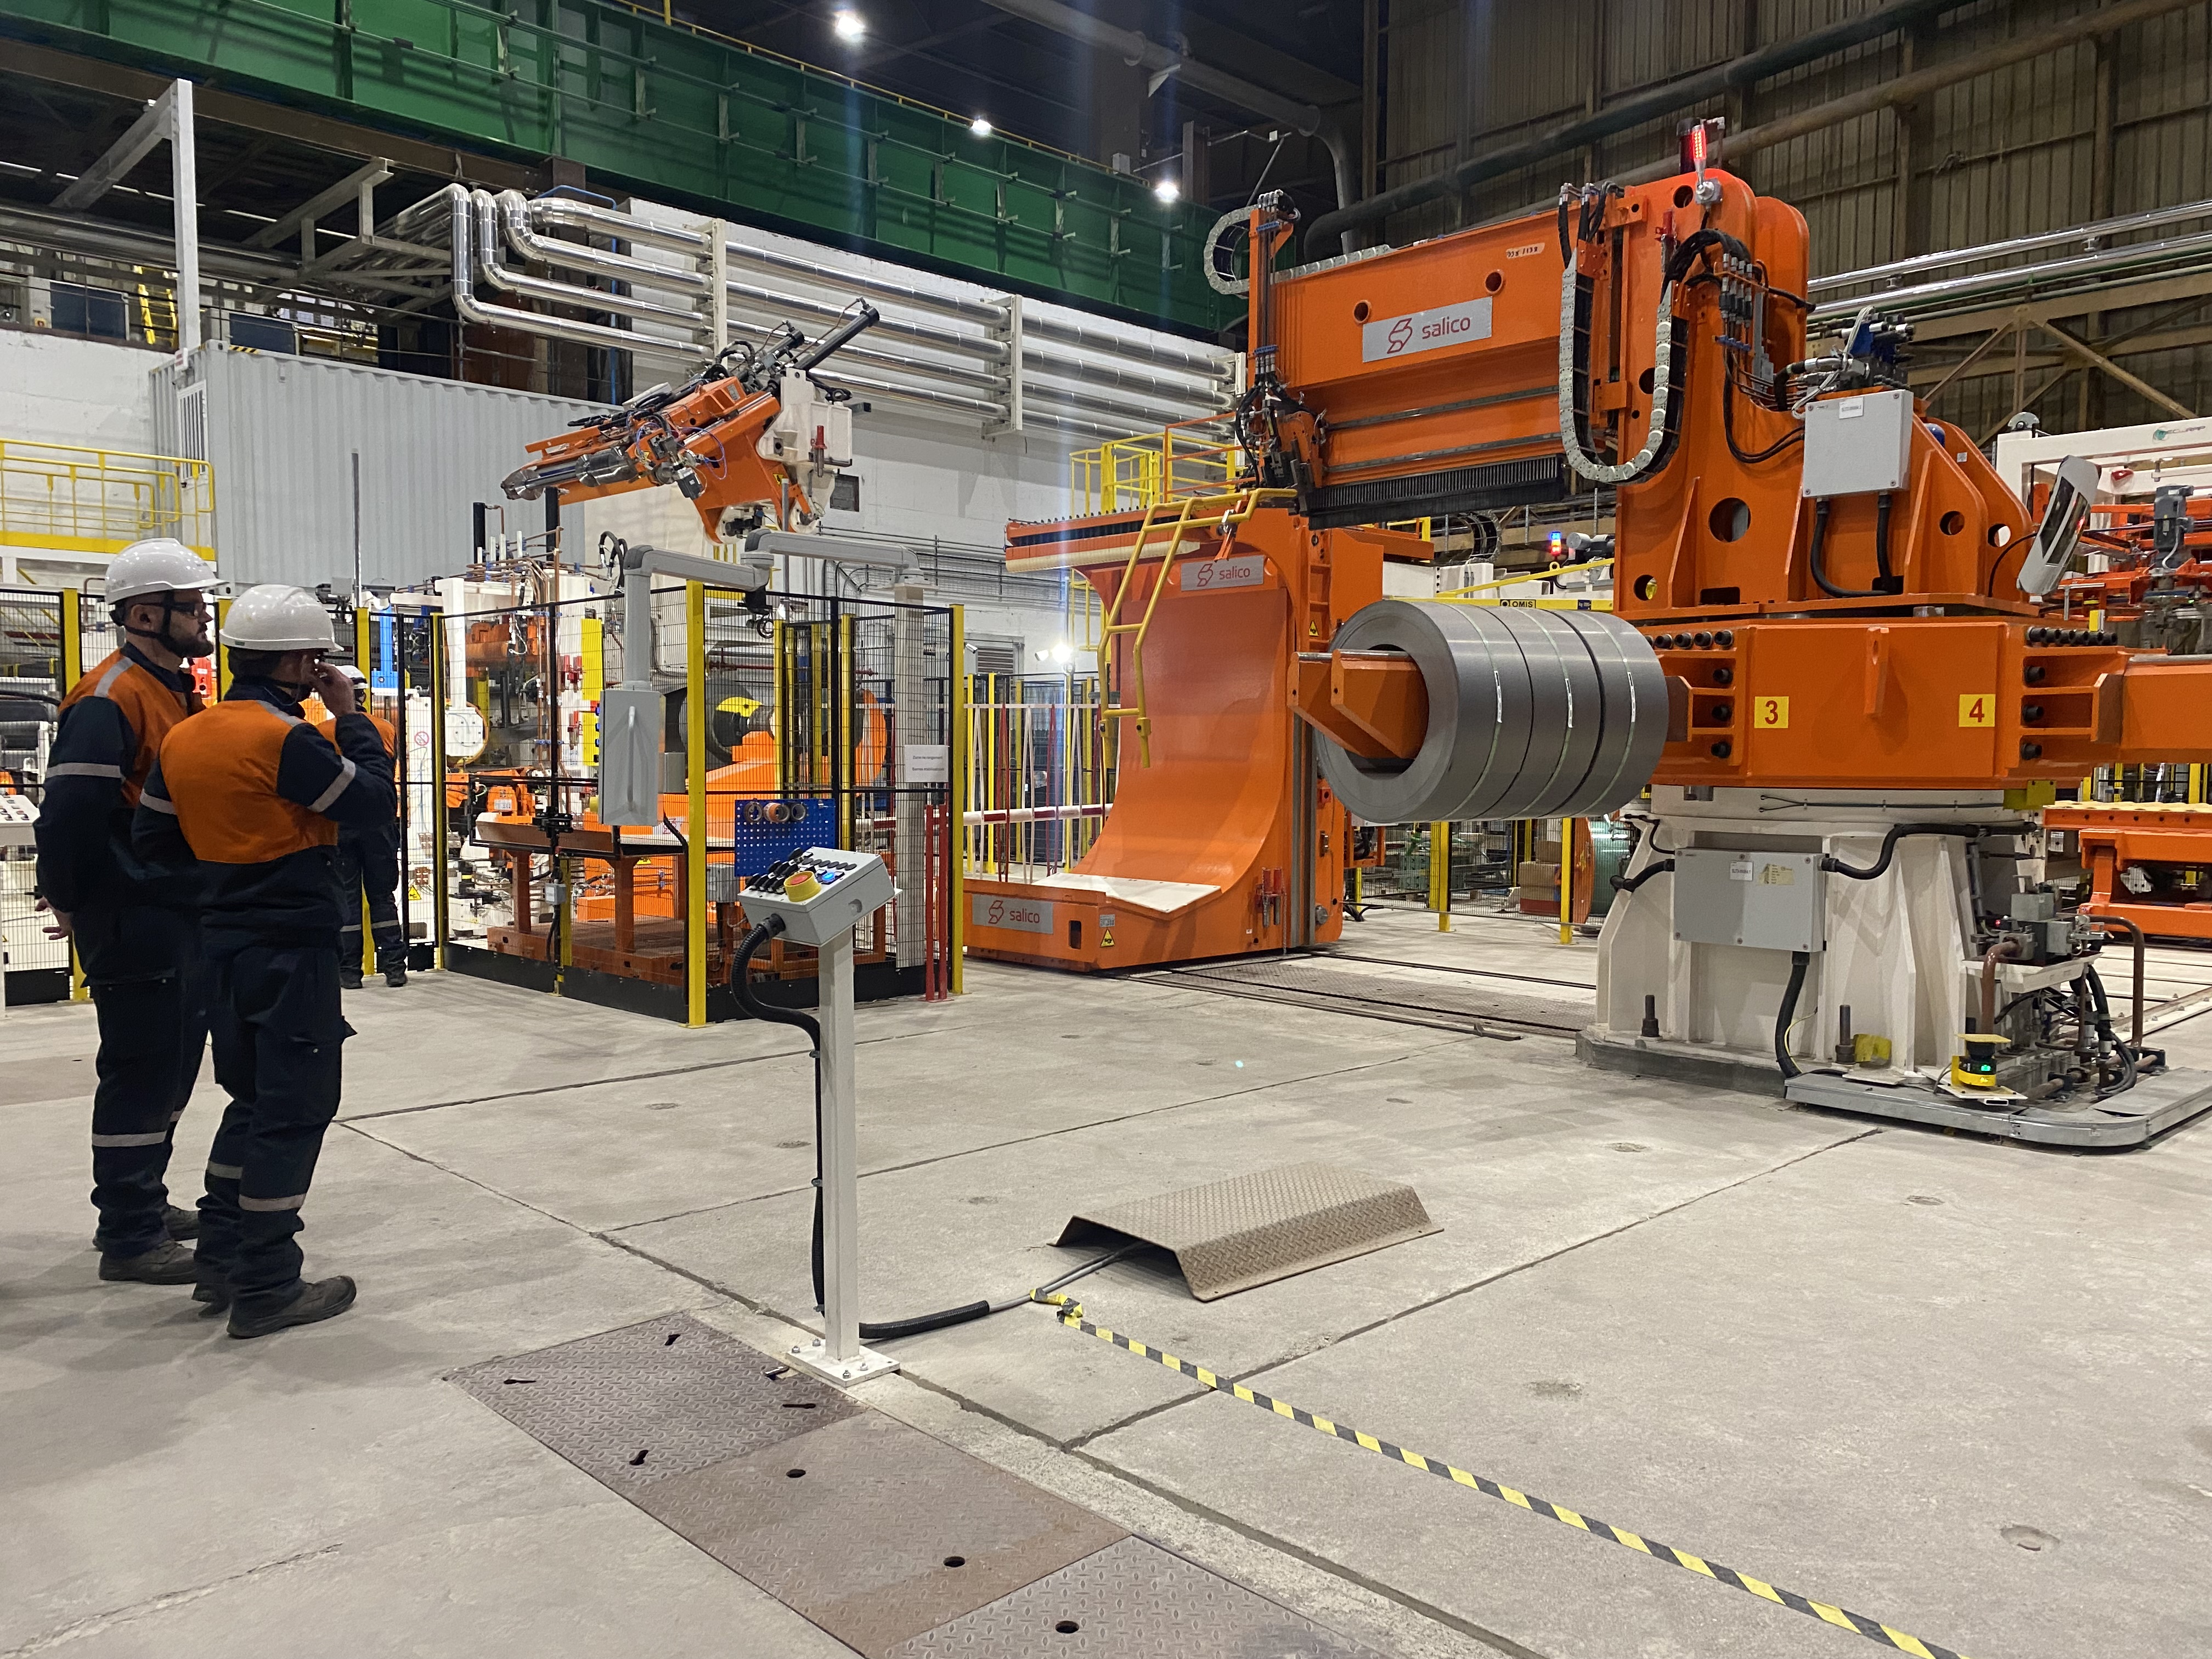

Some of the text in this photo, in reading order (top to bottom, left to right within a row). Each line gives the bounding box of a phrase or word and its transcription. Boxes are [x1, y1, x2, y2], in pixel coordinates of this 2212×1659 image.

[1422, 316, 1470, 340] salico
[1219, 566, 1250, 580] salico
[1764, 700, 1779, 725] 3
[1968, 698, 1985, 724] 4
[1009, 908, 1040, 924] salico
